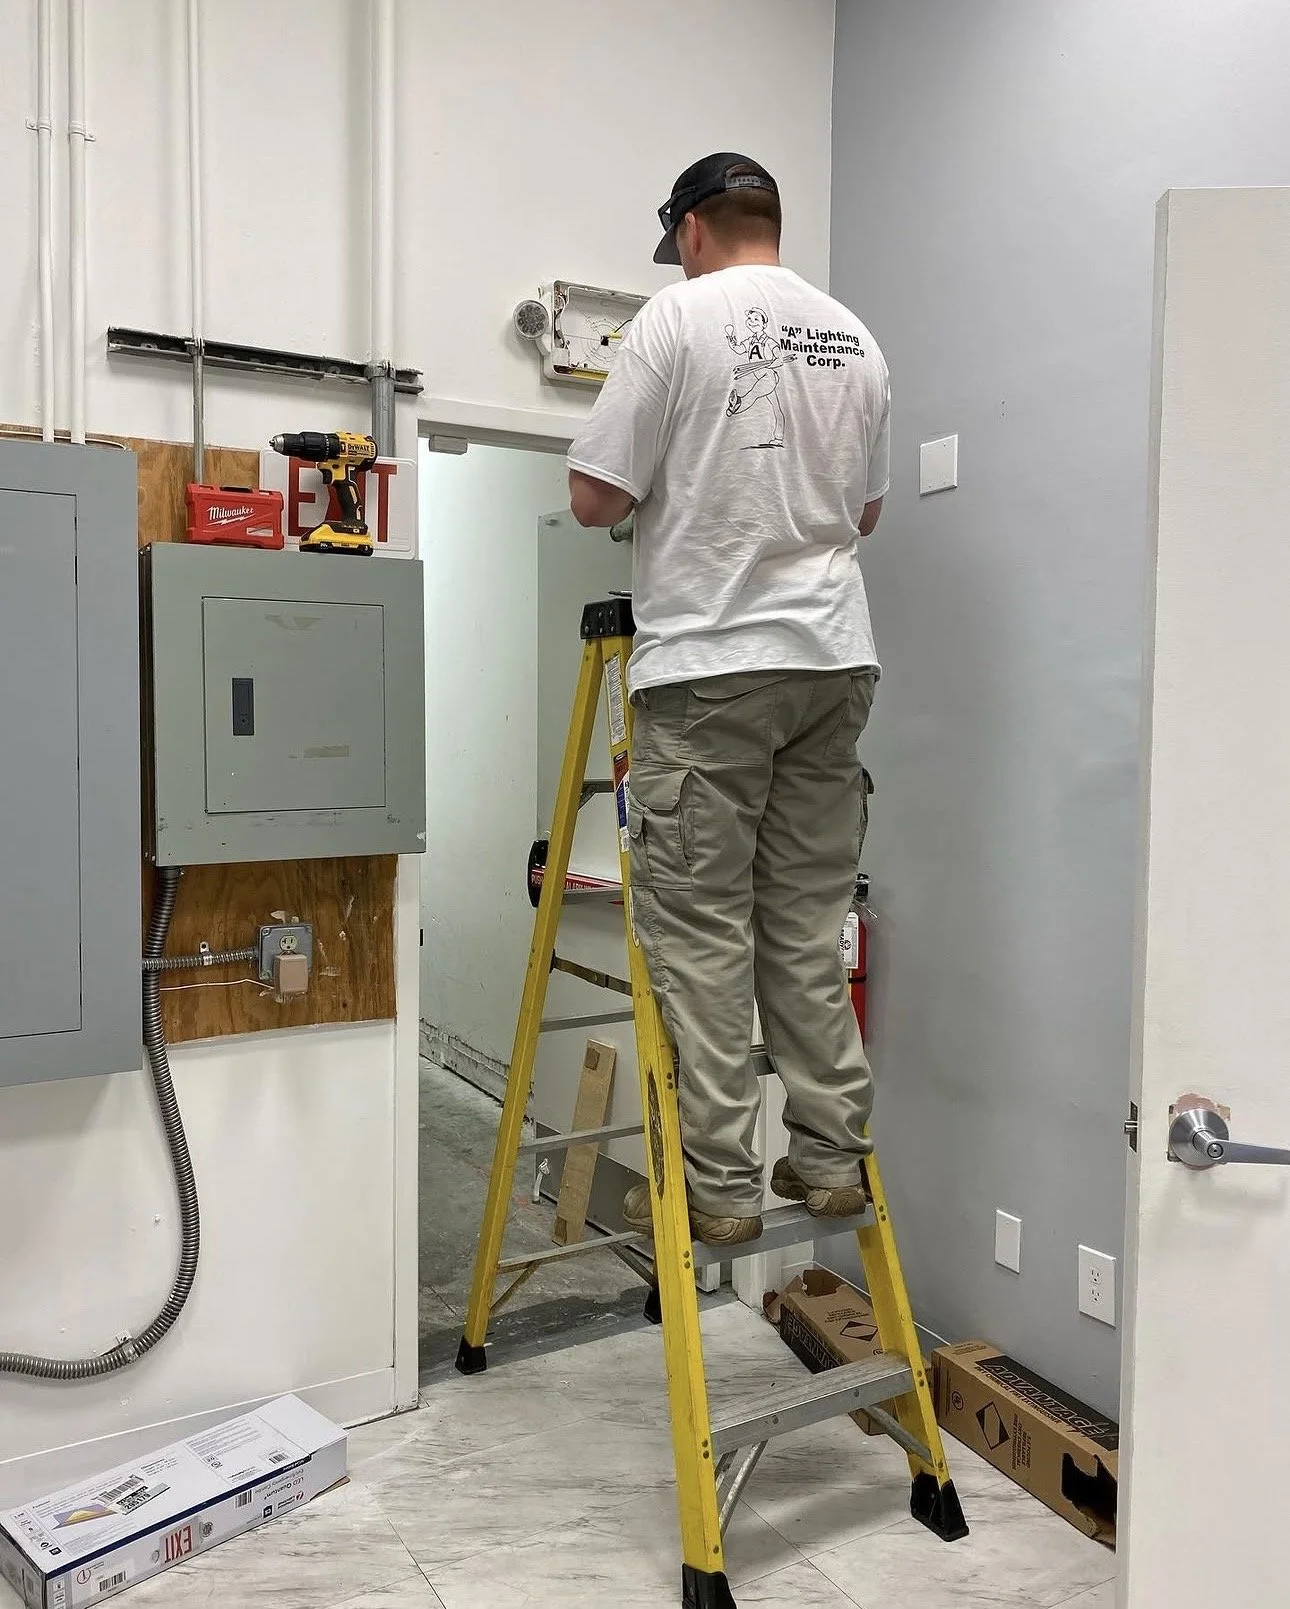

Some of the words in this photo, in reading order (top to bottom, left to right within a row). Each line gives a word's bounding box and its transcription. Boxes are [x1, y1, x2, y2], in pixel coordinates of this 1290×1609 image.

[781, 325, 802, 339] “A”
[806, 328, 860, 347] Lighting
[749, 344, 763, 359] A
[780, 338, 865, 358] Maintenance
[806, 354, 846, 369] Corp.
[207, 505, 254, 520] Milwaukee
[983, 1364, 1105, 1438] ADVANTAGE
[165, 1525, 192, 1563] EXIT
